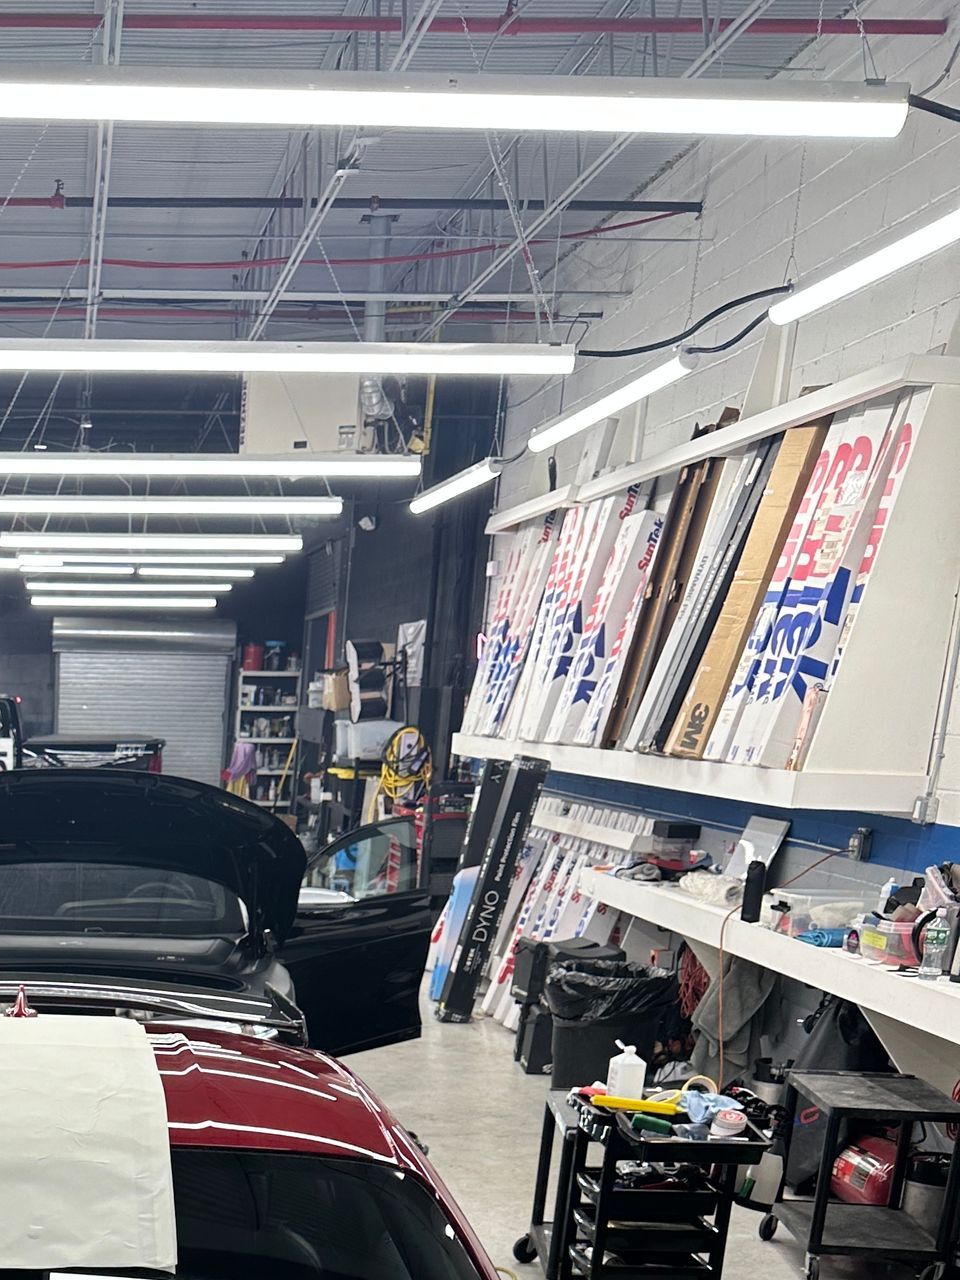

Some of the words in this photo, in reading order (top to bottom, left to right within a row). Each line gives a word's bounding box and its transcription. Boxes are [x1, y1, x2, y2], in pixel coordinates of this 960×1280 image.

[619, 482, 642, 520] SunTe
[637, 518, 664, 572] SunTek
[680, 702, 709, 750] 3M
[500, 827, 516, 863] Protection
[543, 854, 565, 893] SunTek
[472, 890, 500, 943] DYNO
